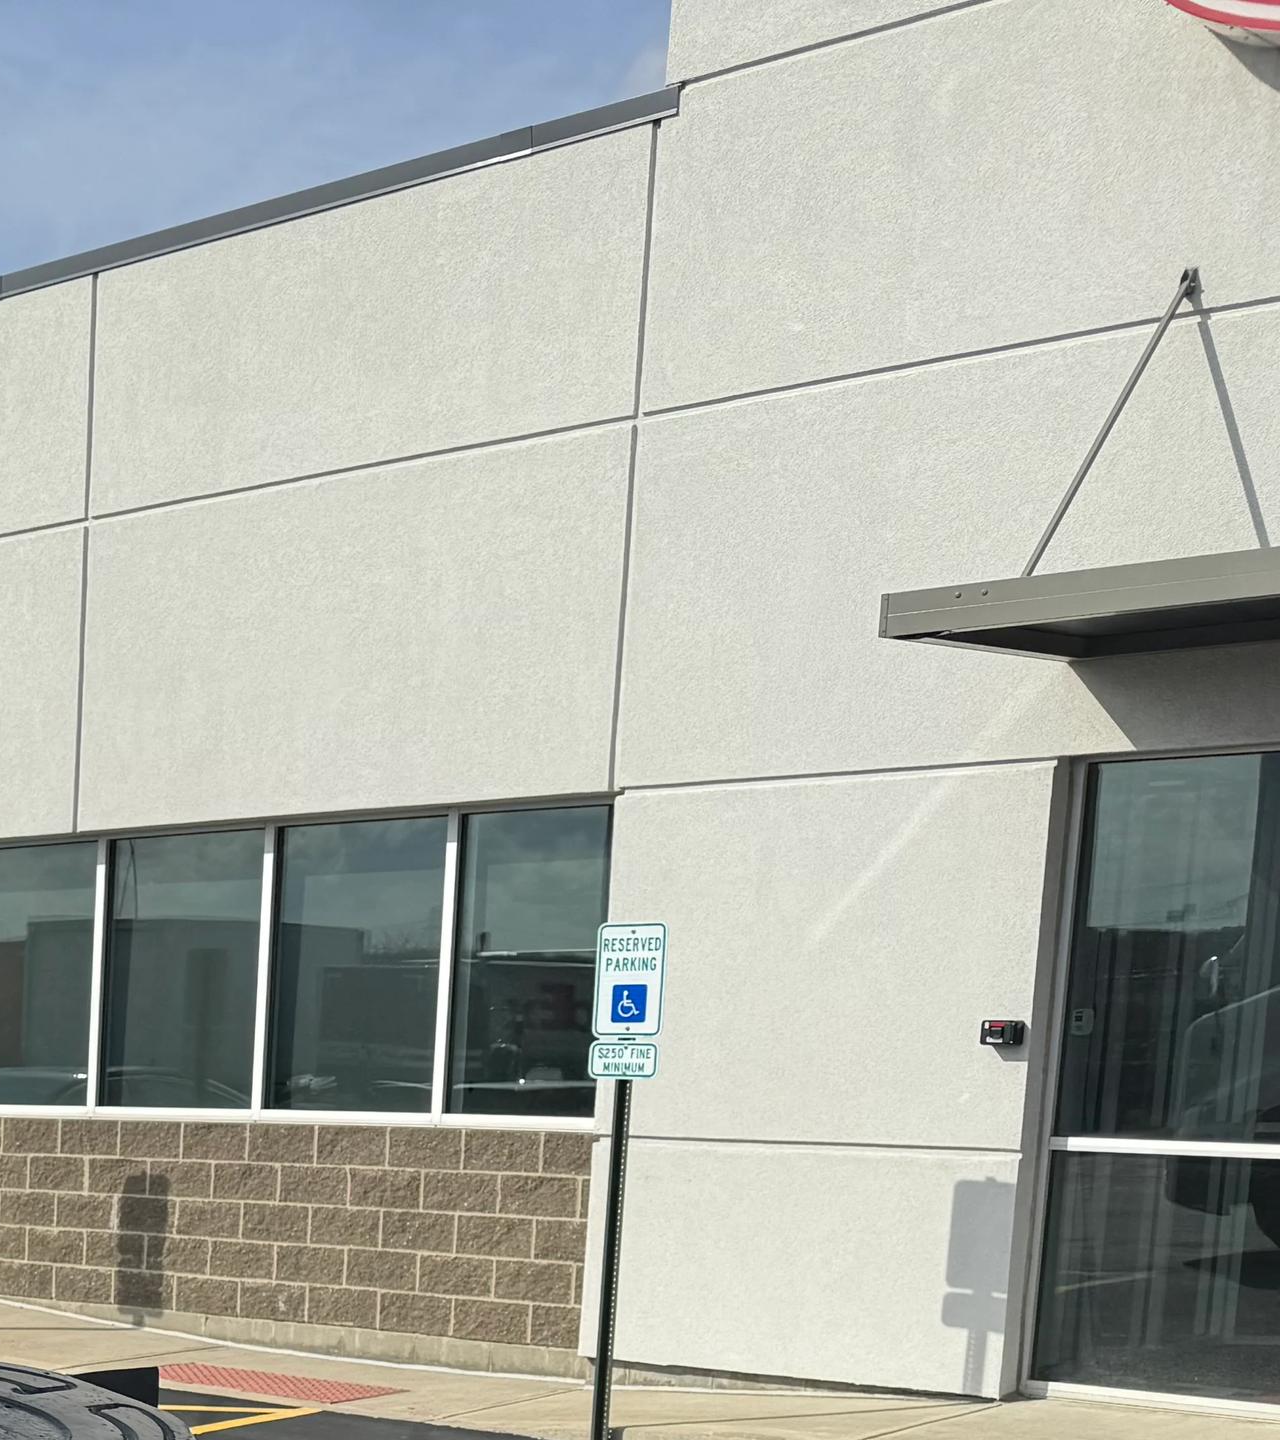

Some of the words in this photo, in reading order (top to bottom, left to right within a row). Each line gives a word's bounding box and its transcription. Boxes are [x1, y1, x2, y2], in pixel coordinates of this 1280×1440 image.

[604, 937, 662, 952] RESERVED
[606, 957, 657, 972] PARKING
[598, 1047, 625, 1060] $250
[630, 1047, 652, 1060] FINE
[602, 1061, 645, 1074] MINIMUM
